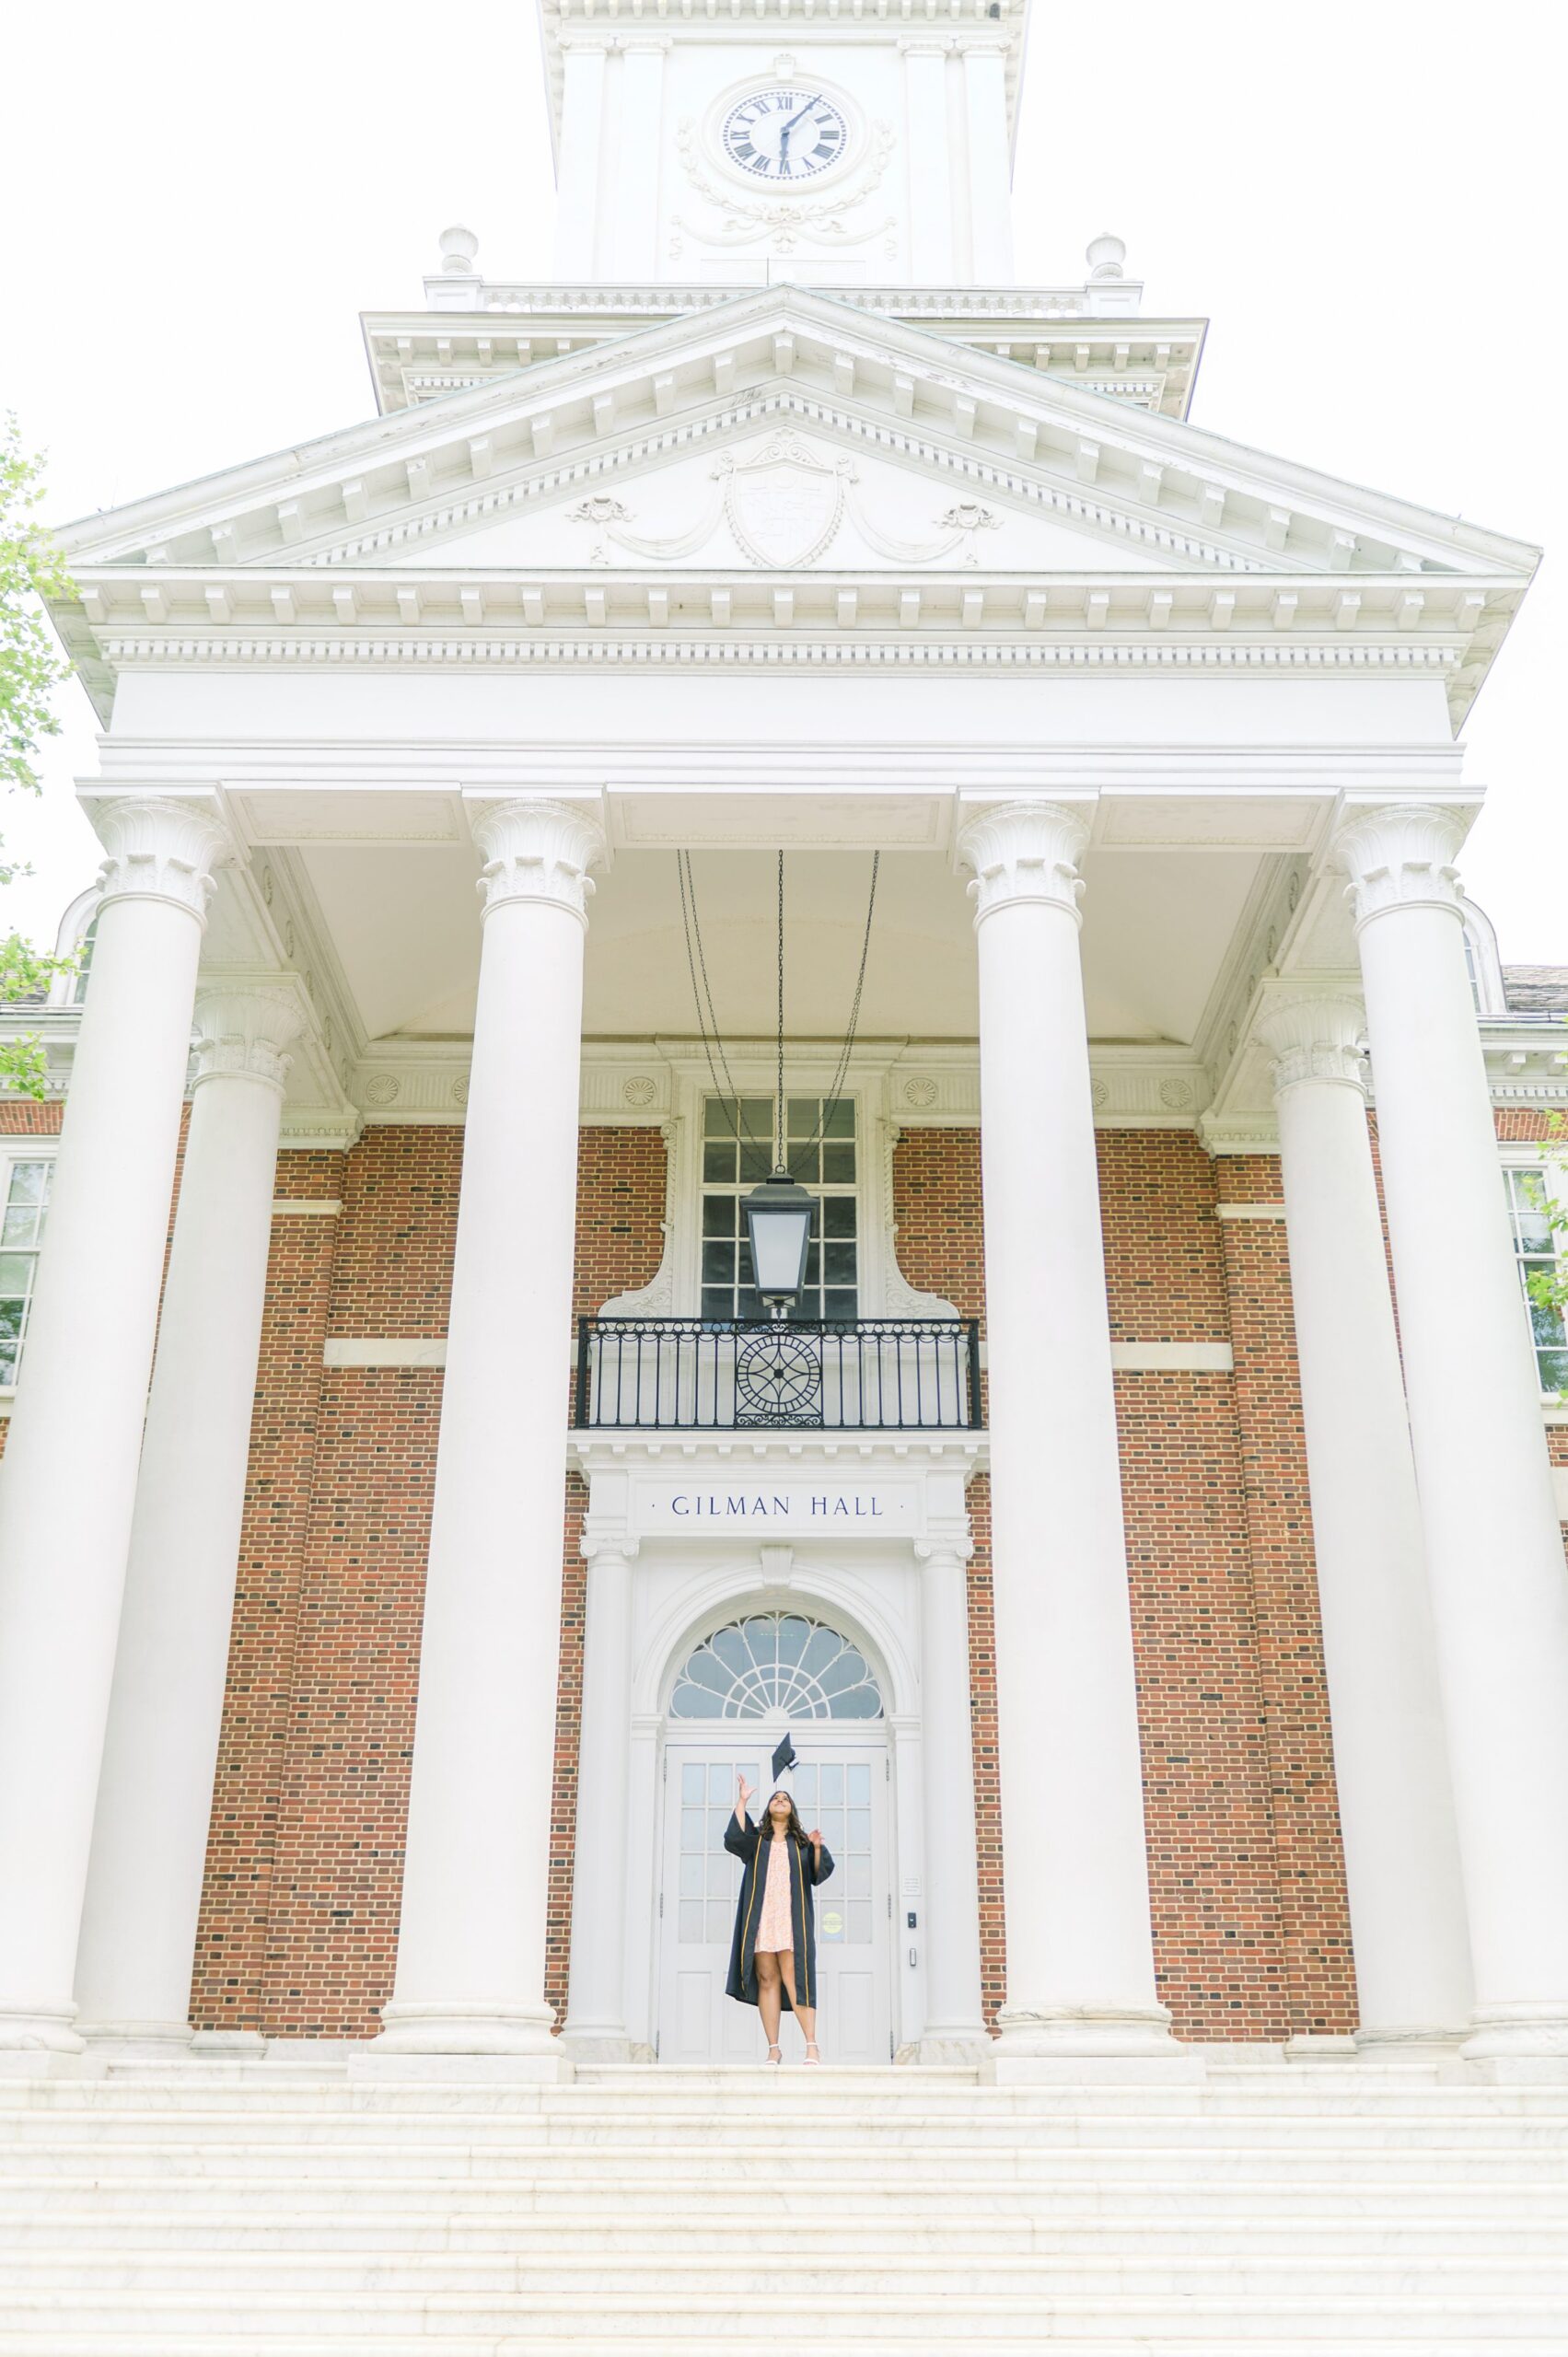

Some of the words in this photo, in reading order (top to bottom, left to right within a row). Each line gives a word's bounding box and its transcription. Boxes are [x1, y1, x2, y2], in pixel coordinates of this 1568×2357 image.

[752, 100, 771, 116] XI
[777, 97, 793, 110] XII
[736, 113, 756, 125] X
[730, 130, 750, 140] IX
[819, 130, 840, 140] III
[671, 1496, 790, 1515] GILMAN
[810, 1496, 884, 1515] HALL
